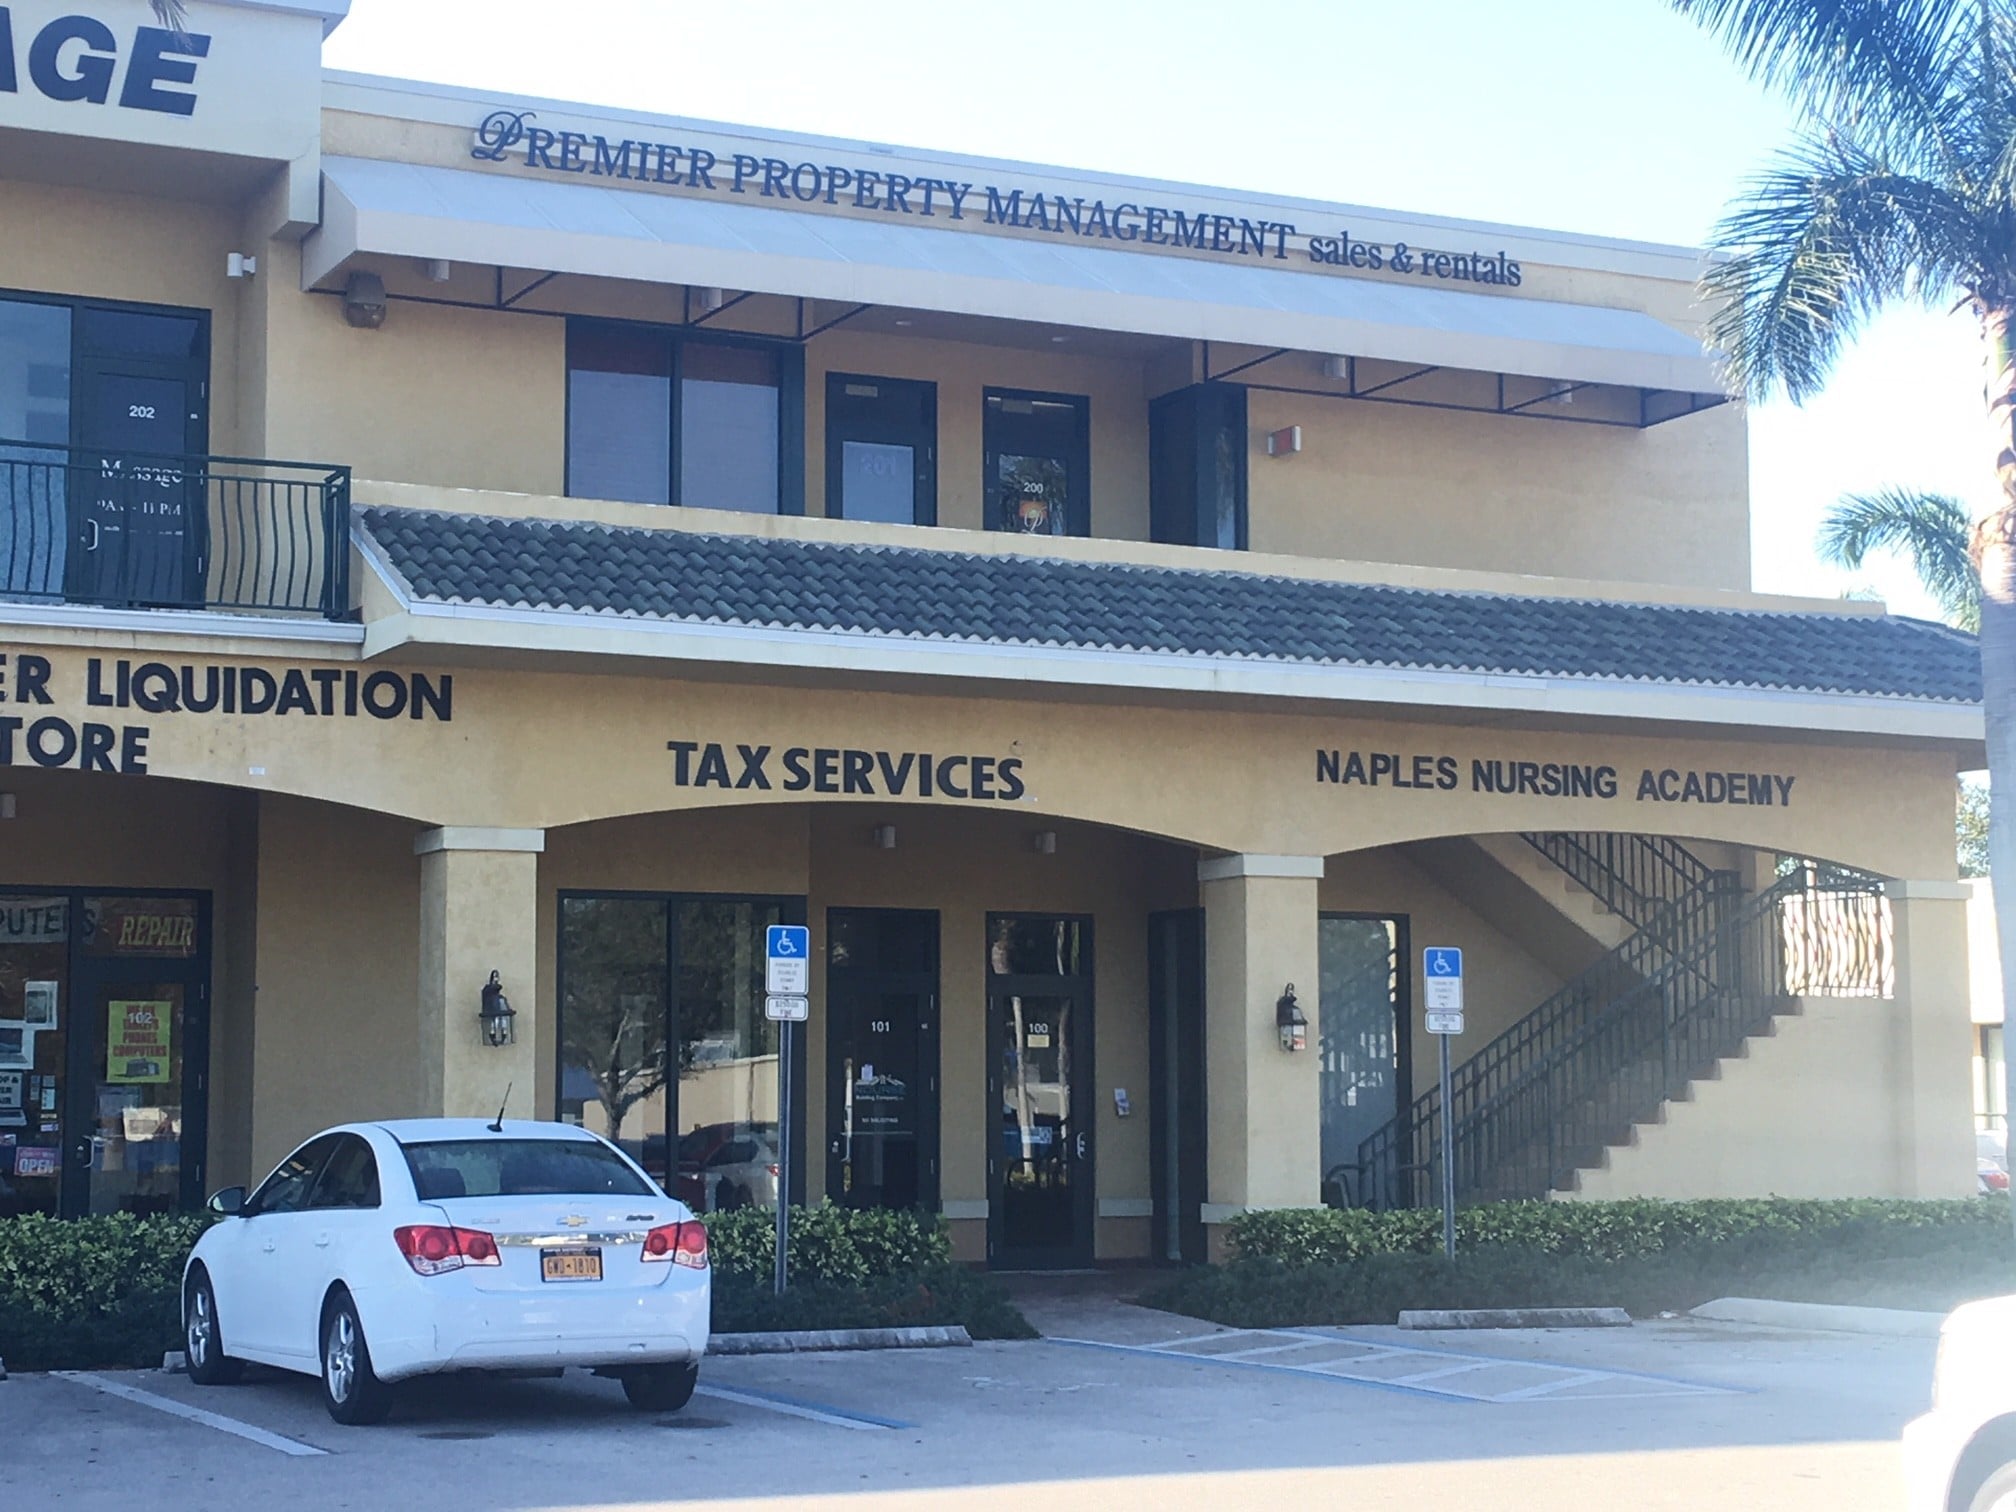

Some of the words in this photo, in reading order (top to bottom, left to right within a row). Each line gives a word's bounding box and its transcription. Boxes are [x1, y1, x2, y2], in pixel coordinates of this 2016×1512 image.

[0, 6, 211, 116] GE
[471, 110, 716, 190] PREMIER
[730, 153, 972, 220] PROPERTY
[983, 185, 1296, 260] MANAGEMENT
[1308, 230, 1382, 270] sales
[1389, 242, 1414, 274] &
[1420, 250, 1521, 287] rentals
[129, 405, 155, 418] 202
[1023, 481, 1044, 494] 200
[87, 658, 453, 722] LIQUIDATION
[667, 741, 772, 790] TAX
[782, 747, 1025, 801] SERVICES
[1316, 749, 1458, 790] NAPLES
[1472, 759, 1617, 799] NURSING
[1636, 769, 1796, 806] ACADEMY
[118, 915, 194, 946] REPAIR
[128, 1012, 153, 1024] 102
[871, 1021, 890, 1032] 101
[1028, 1023, 1049, 1034] 100
